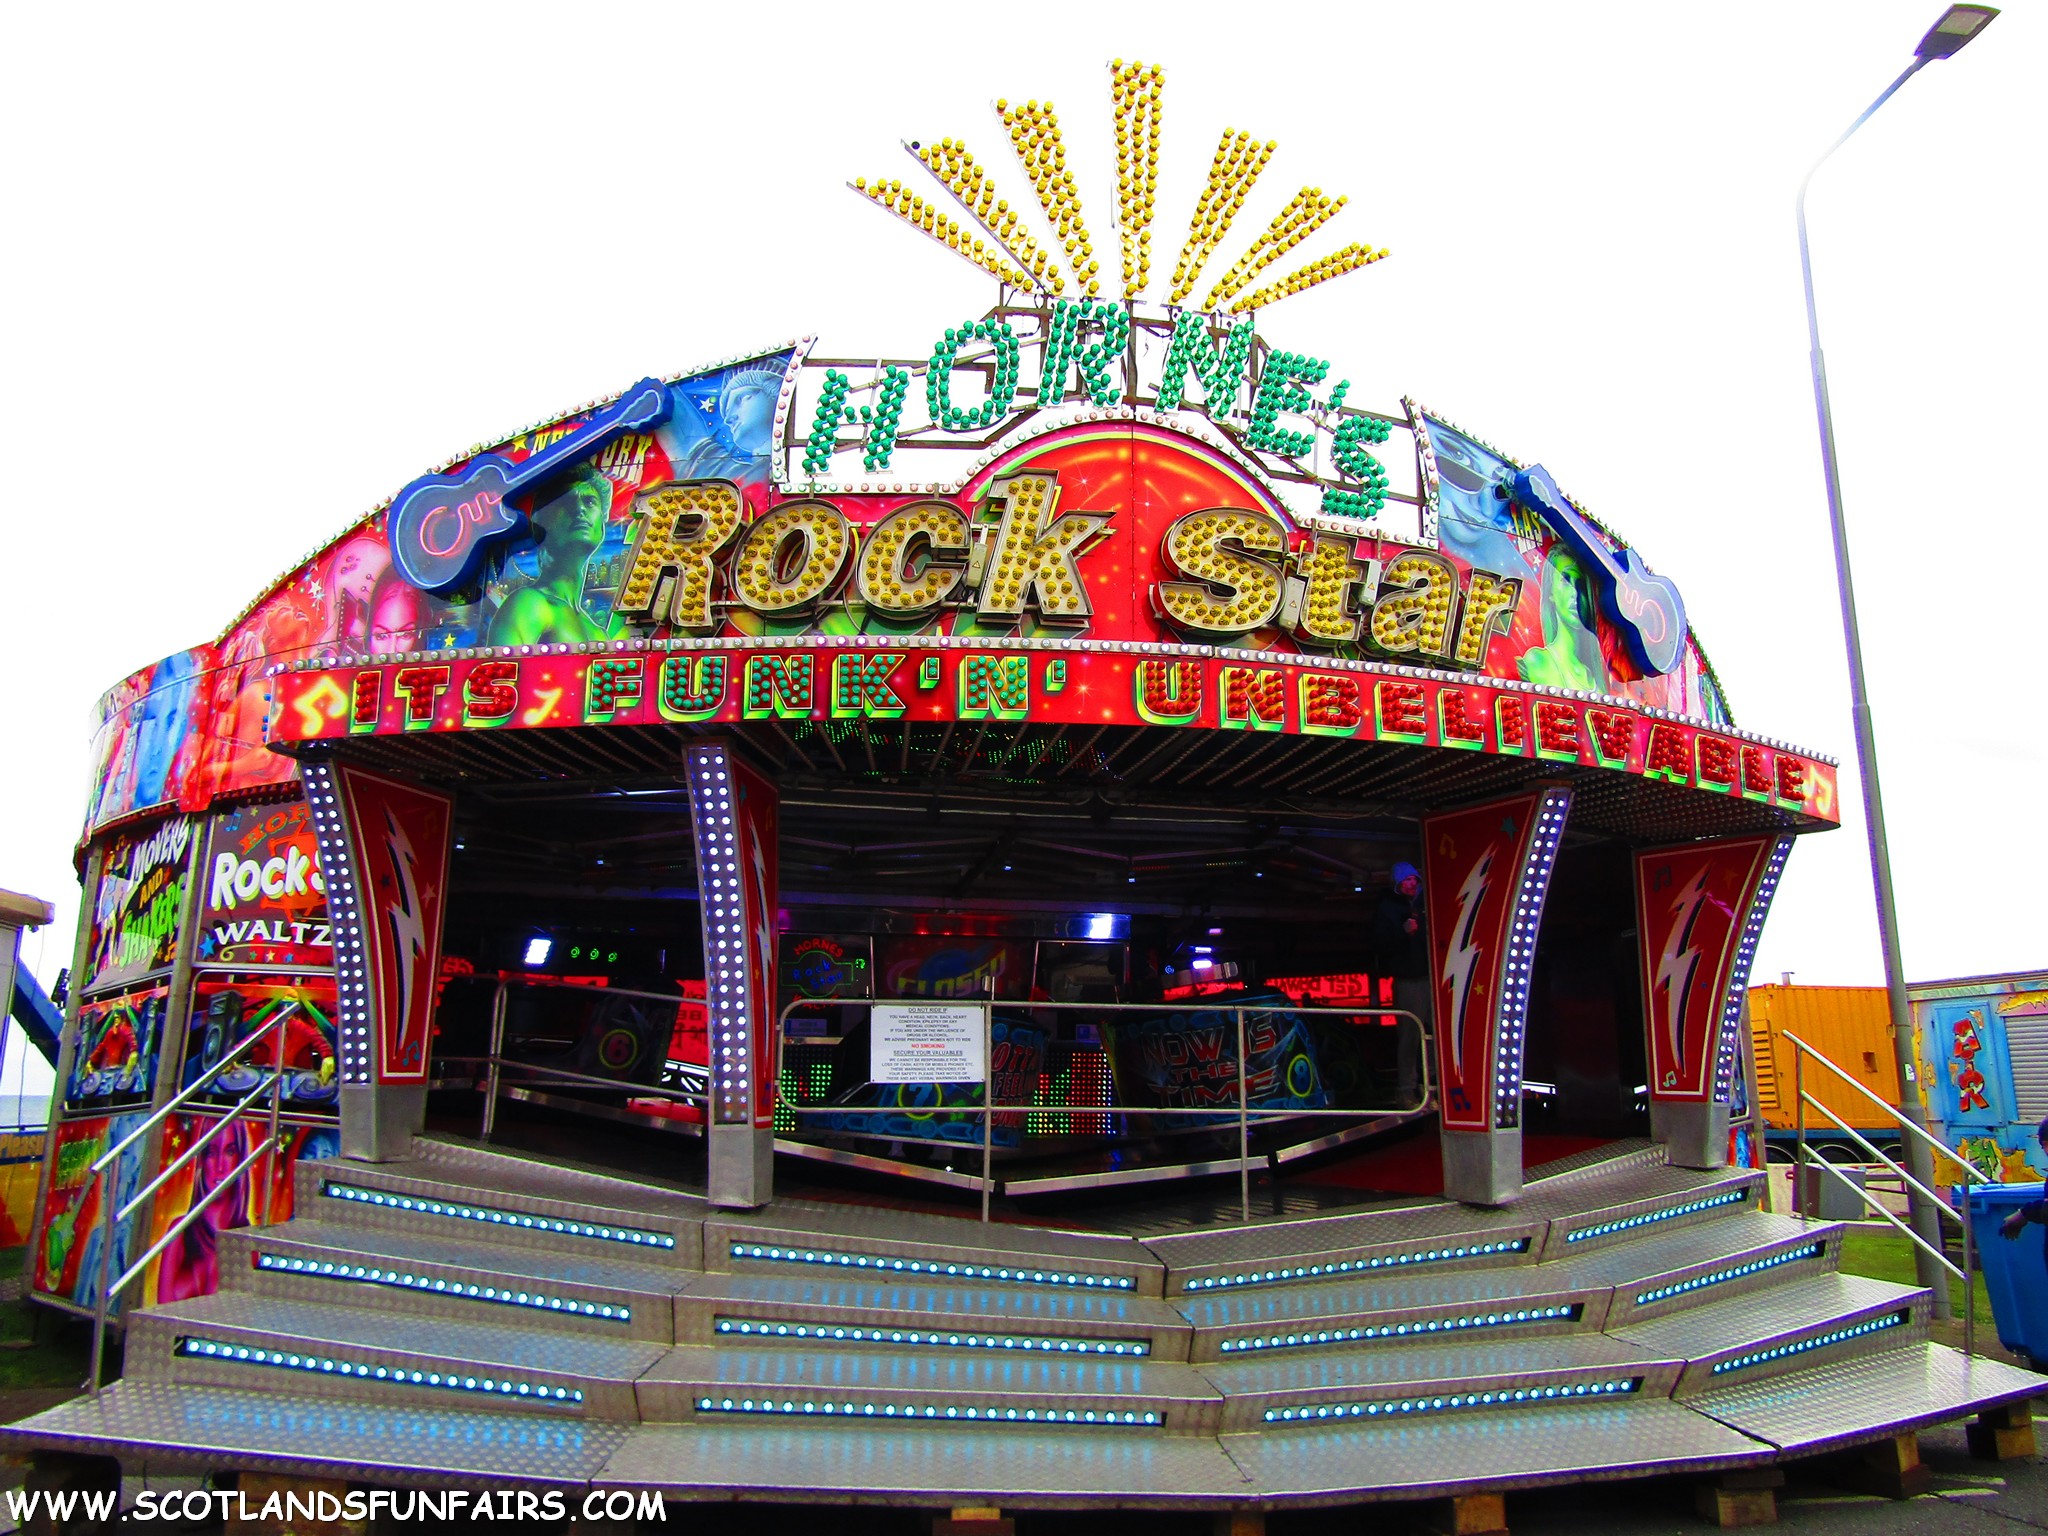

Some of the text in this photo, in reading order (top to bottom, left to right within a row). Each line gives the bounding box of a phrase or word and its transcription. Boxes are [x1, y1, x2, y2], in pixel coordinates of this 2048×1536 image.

[1150, 506, 1522, 669] Star
[349, 661, 519, 734] ITS
[1132, 658, 1808, 811] UNBELIEVABLE
[129, 815, 191, 890] MOVERS
[139, 867, 164, 909] AND
[794, 938, 843, 958] HORNES
[1141, 1026, 1224, 1066] NOW
[1148, 1065, 1281, 1109] TIME
[1172, 1062, 1238, 1083] THE
